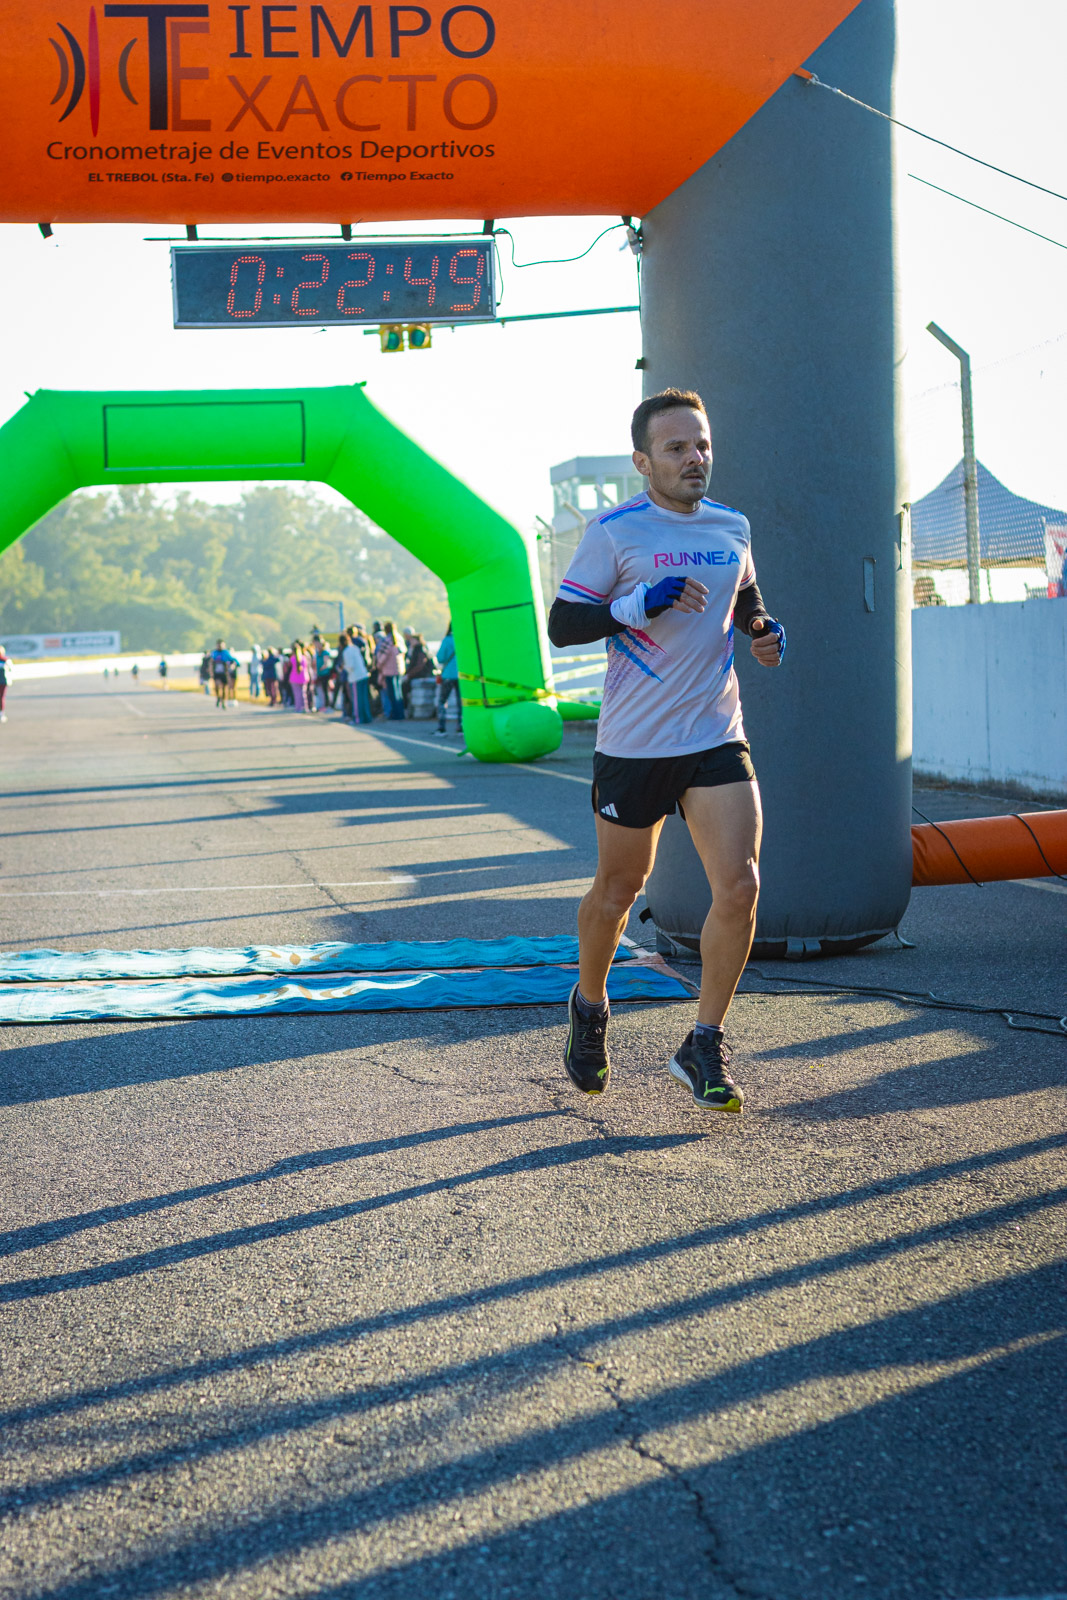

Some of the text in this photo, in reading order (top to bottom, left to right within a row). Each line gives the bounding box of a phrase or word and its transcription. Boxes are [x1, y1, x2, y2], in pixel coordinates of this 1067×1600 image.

[104, 3, 496, 132] TIEMPO
[170, 21, 499, 133] EXACTO
[46, 140, 495, 164] Cronometraje de Eventos Deportivos
[88, 172, 214, 183] EL TREBOL (Sta. Fe)
[235, 173, 331, 184] tiempo.exacto
[355, 171, 454, 182] Tiempo Exacto
[226, 249, 485, 318] 0:22:49
[654, 551, 741, 569] RUNNEA
